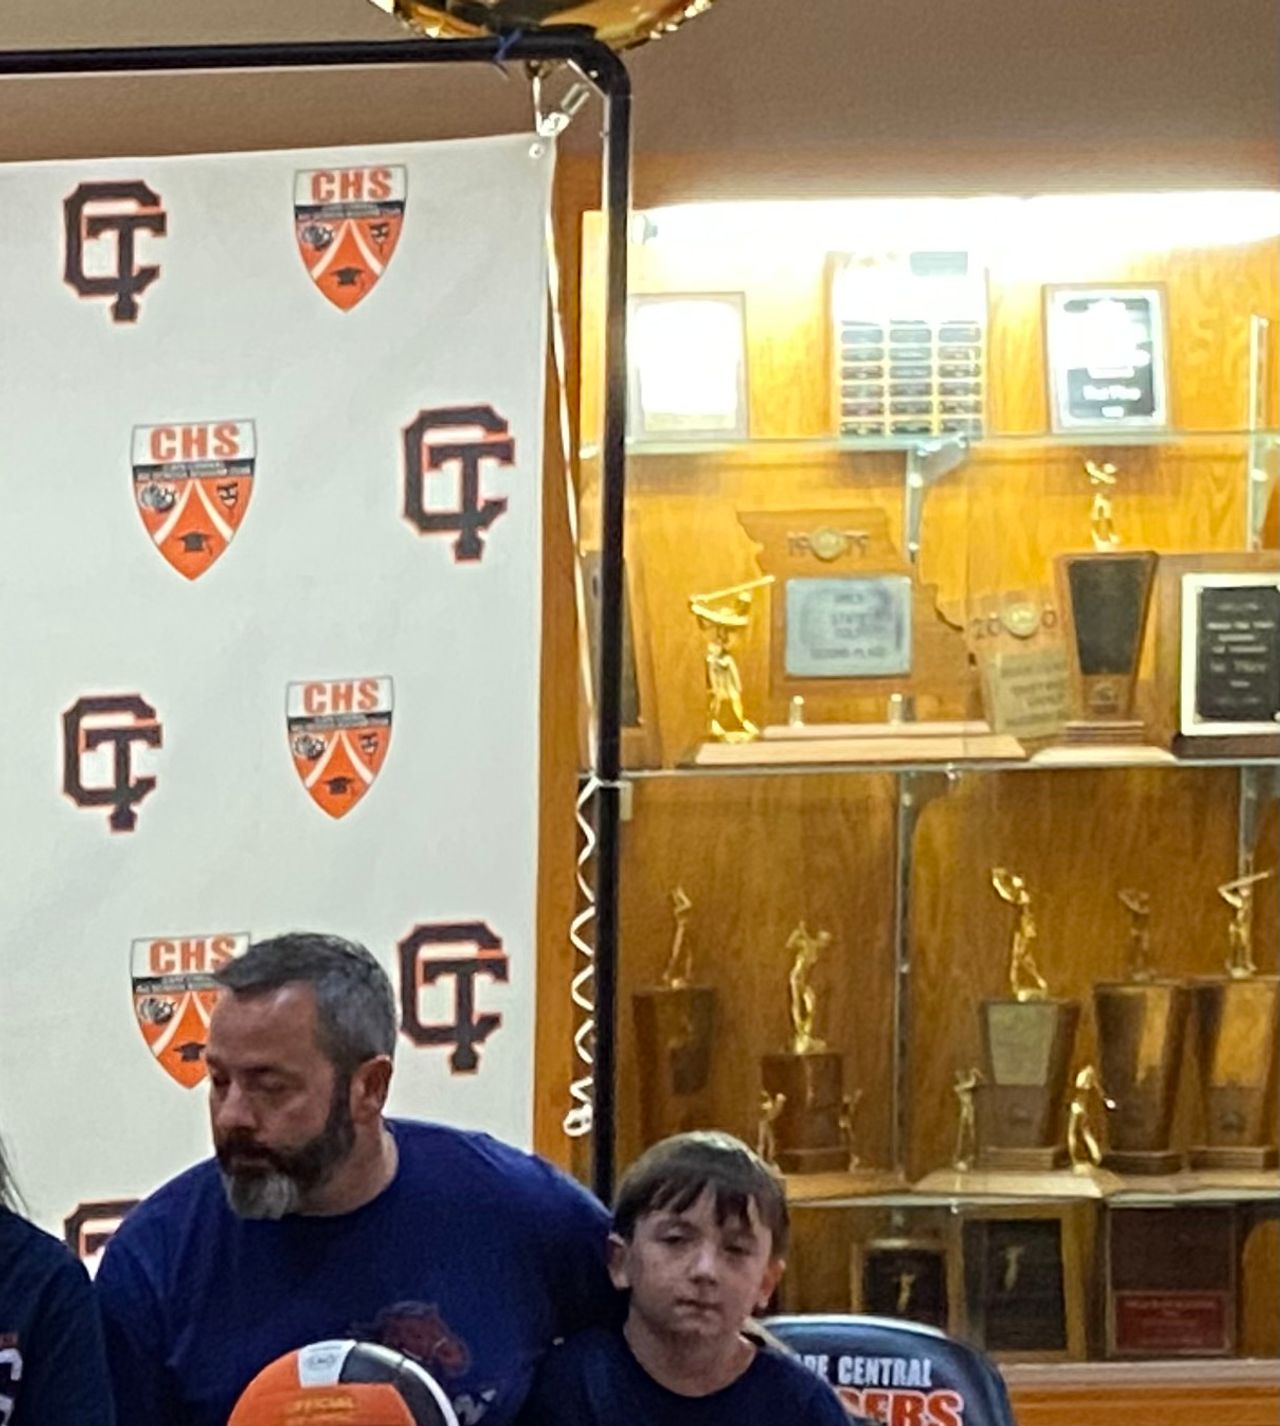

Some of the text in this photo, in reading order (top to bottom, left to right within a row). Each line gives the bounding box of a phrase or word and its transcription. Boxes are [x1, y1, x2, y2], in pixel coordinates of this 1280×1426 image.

[311, 169, 393, 202] CHS
[151, 422, 239, 461] CHS
[303, 681, 380, 715] CHS
[148, 939, 237, 975] CHS
[838, 1355, 933, 1387] CENTRAL
